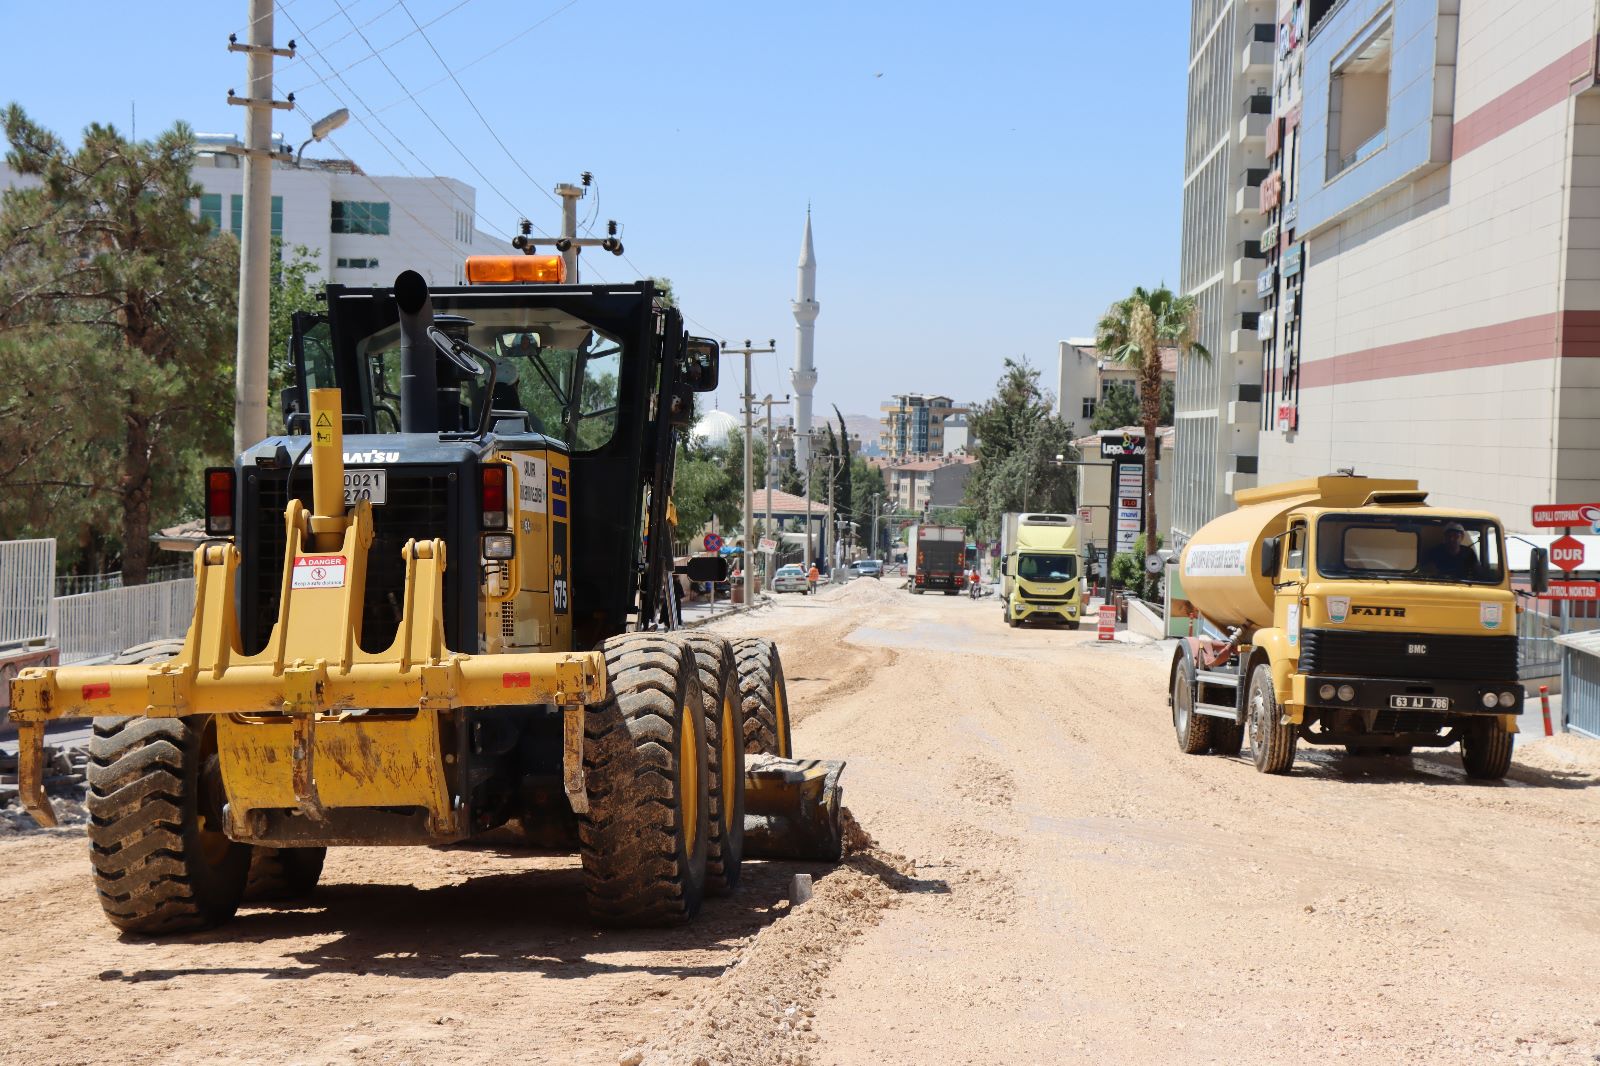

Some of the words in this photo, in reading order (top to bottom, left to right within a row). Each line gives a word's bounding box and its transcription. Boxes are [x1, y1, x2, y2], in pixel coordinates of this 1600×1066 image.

[1133, 446, 1146, 455] AV
[304, 450, 400, 463] KATSU
[1553, 549, 1582, 560] DUR
[554, 580, 567, 608] 675
[1408, 644, 1426, 654] BMC
[1396, 698, 1407, 707] 63
[1412, 699, 1423, 708] AJ
[1431, 699, 1447, 708] 786
